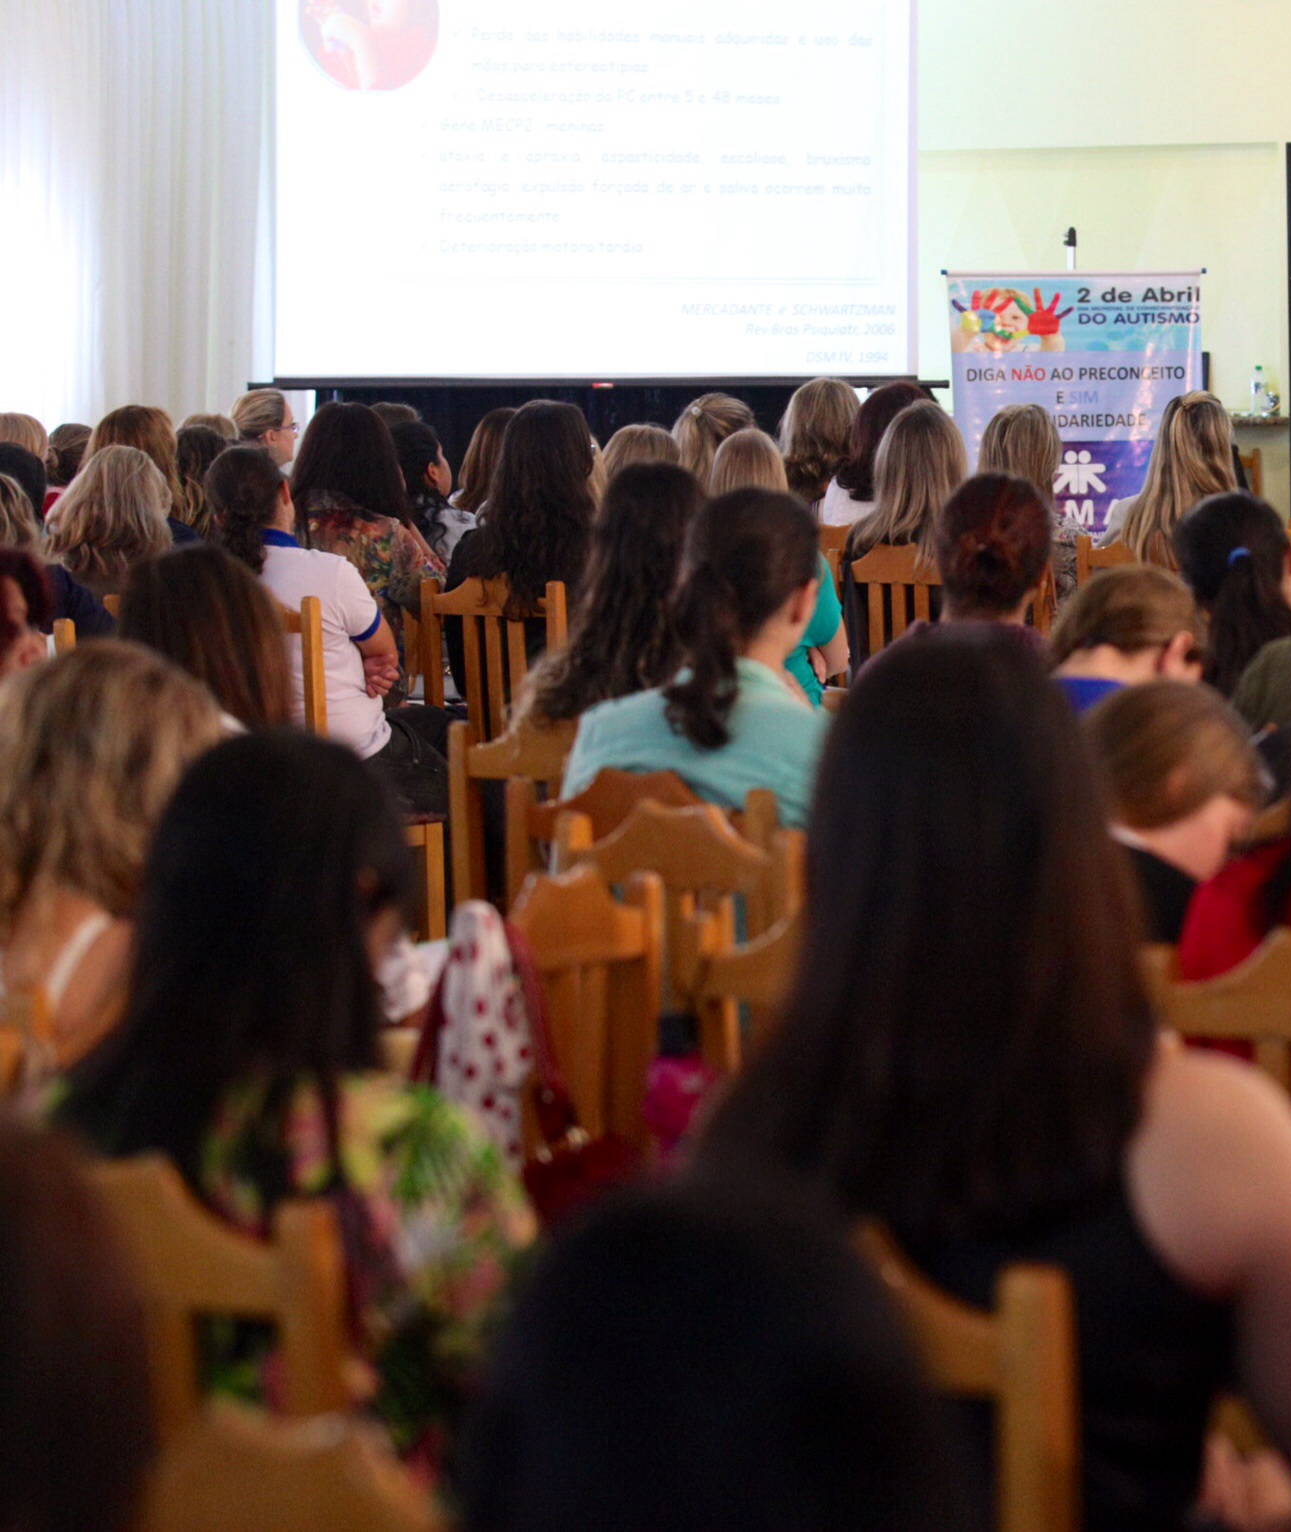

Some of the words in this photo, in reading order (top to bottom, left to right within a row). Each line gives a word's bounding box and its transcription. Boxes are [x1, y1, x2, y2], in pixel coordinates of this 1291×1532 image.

[558, 28, 640, 43] habilidades
[849, 33, 872, 47] das
[513, 62, 546, 73] para
[640, 92, 680, 103] entre
[736, 95, 781, 105] meses
[656, 181, 673, 193] de
[832, 183, 871, 196] muito
[1077, 287, 1091, 303] 2
[1101, 286, 1132, 303] de
[1141, 286, 1200, 303] Abril
[681, 304, 773, 316] MERCADANTE
[778, 306, 786, 316] e
[792, 304, 897, 316] SCHWARTZMAN
[1078, 313, 1107, 325] DO
[1113, 312, 1200, 325] AUTISMO
[746, 323, 769, 335] Rev
[771, 322, 799, 335] Bras
[864, 323, 895, 335] 2006
[806, 352, 835, 363] DSM
[859, 352, 888, 363] 1994
[966, 368, 1006, 382] DIGA
[1011, 365, 1046, 381] NÃO
[1051, 367, 1074, 380] AO
[1079, 366, 1185, 381] PRECONCEITO
[1056, 391, 1064, 404] E
[1069, 390, 1099, 404] SIM
[1053, 413, 1147, 428] IDARIEDADE
